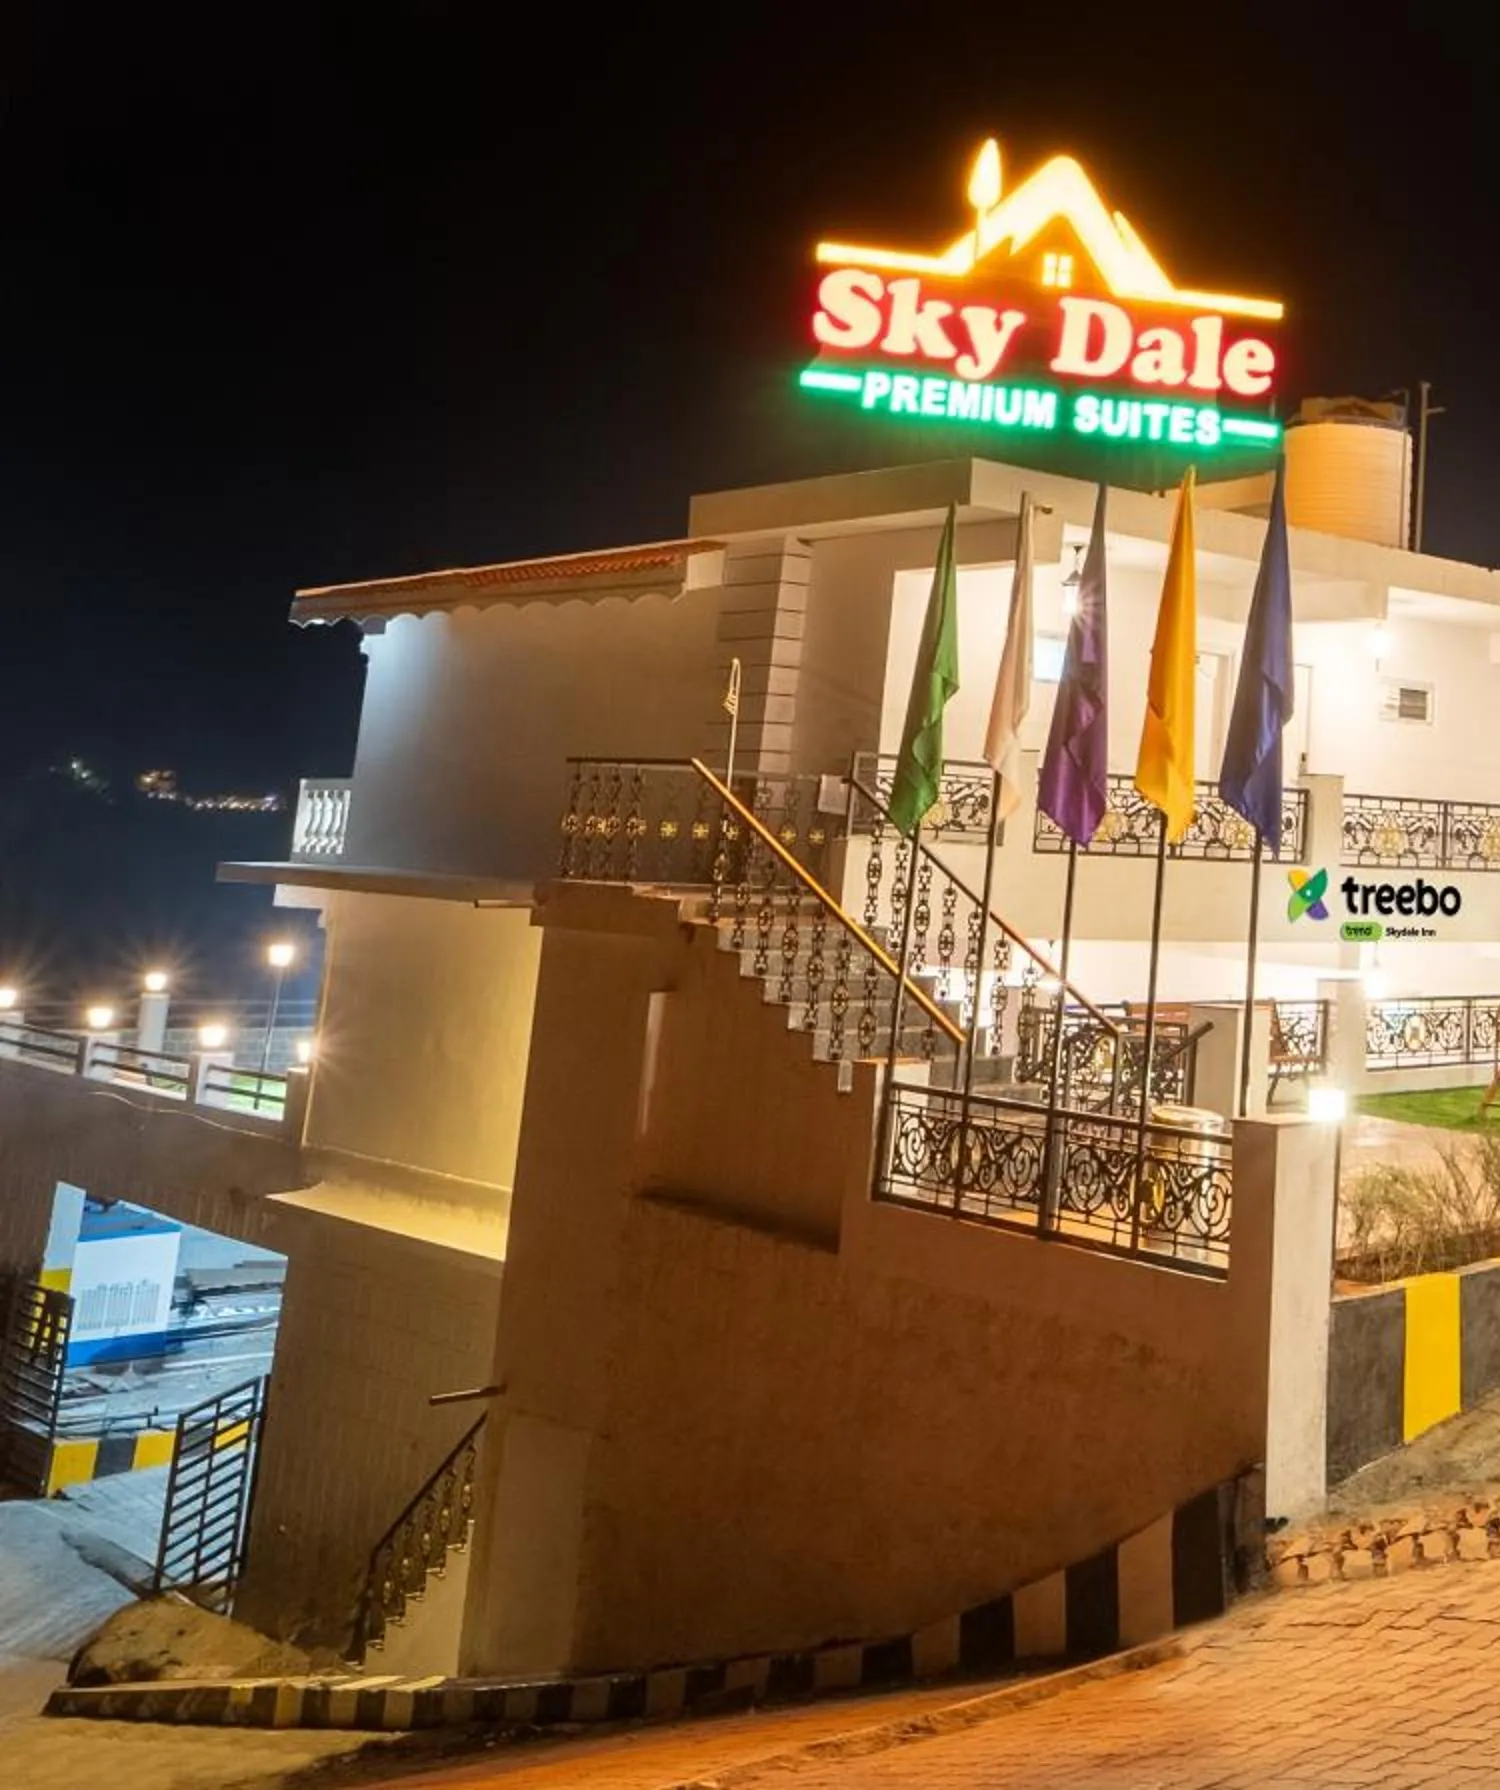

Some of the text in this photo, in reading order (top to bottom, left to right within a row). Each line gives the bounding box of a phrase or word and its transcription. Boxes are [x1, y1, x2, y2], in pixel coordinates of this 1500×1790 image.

[813, 268, 1275, 395] Sky Dale
[860, 371, 1222, 446] PREMIUM SUITES
[1340, 876, 1462, 917] treebo
